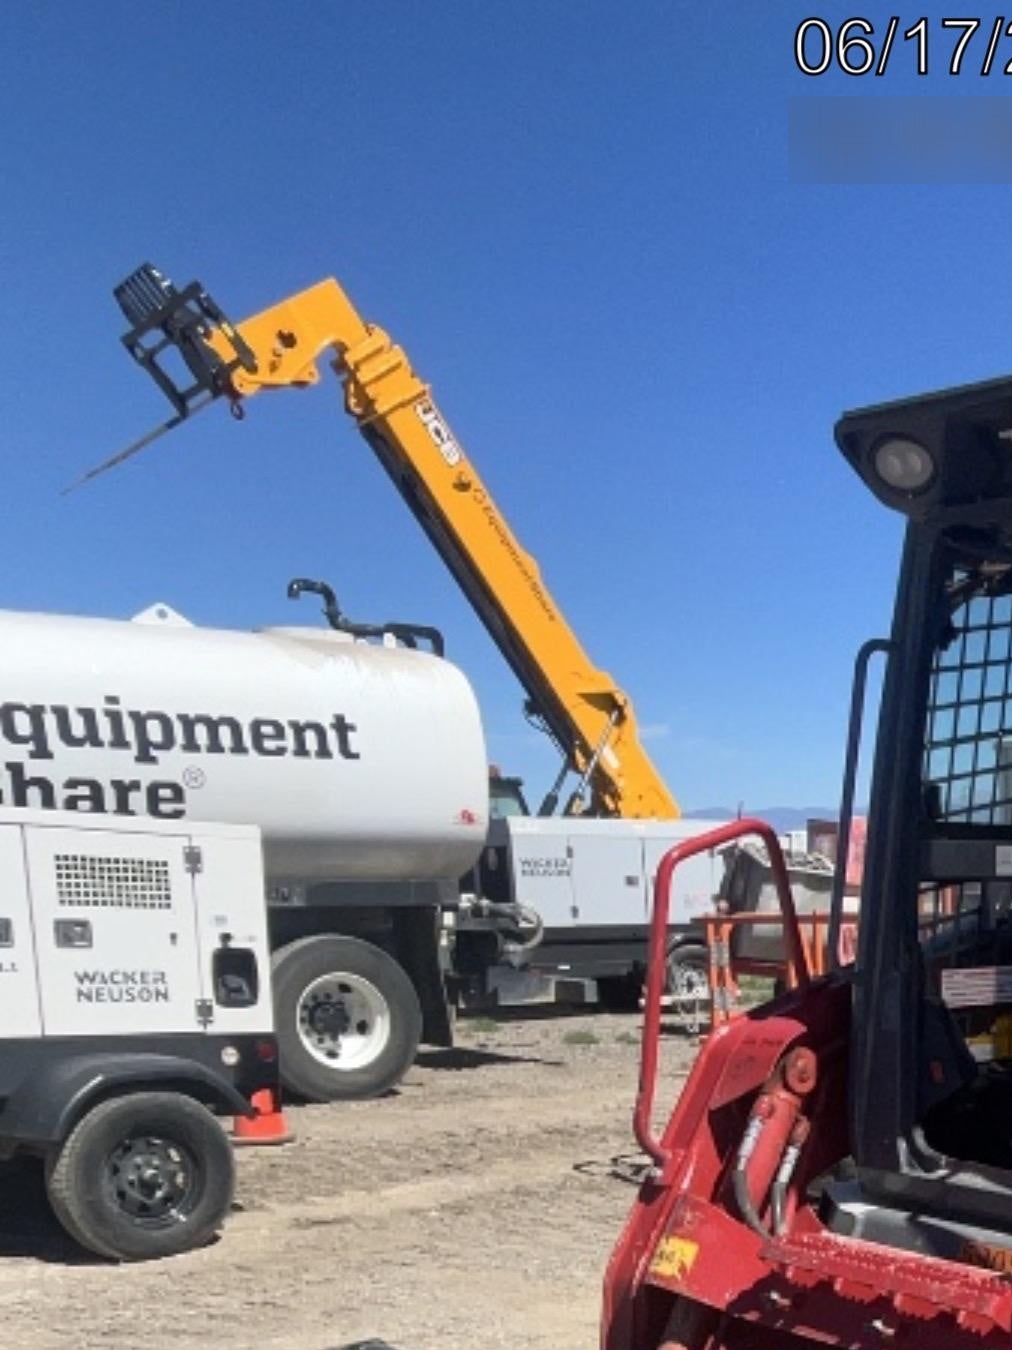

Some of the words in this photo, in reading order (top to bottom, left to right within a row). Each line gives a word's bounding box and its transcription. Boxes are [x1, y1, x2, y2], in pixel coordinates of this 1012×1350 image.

[0, 695, 361, 765] quipment
[74, 970, 168, 986] WACKER
[76, 986, 170, 1003] NEUSON
